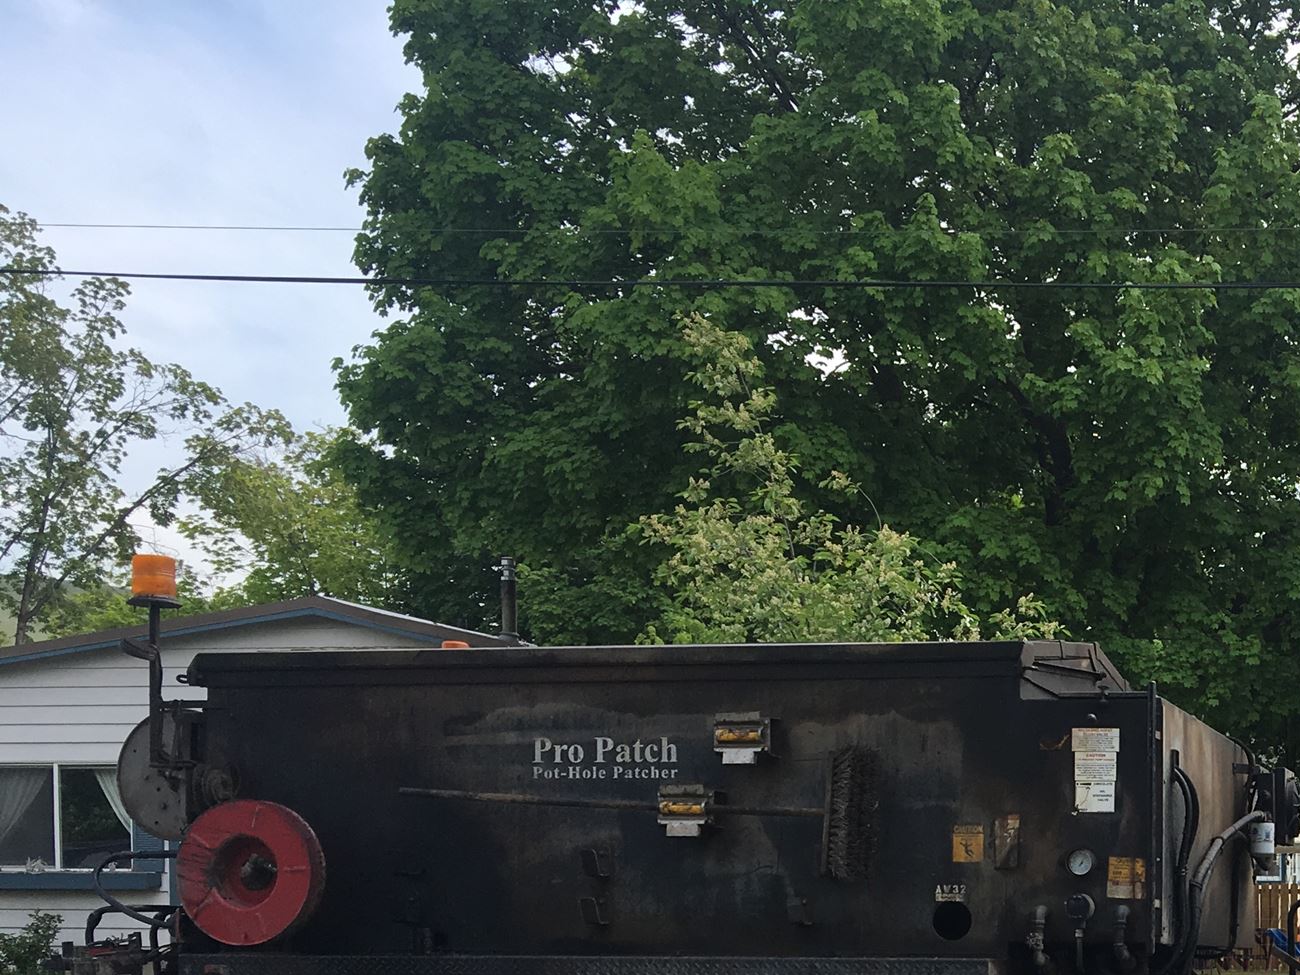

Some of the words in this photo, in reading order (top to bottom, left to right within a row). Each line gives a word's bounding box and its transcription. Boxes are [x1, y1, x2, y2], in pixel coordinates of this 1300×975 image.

[532, 737, 584, 763] Pro
[594, 736, 678, 763] Patch
[533, 766, 606, 779] Pot-Hole
[613, 766, 678, 779] Patcher
